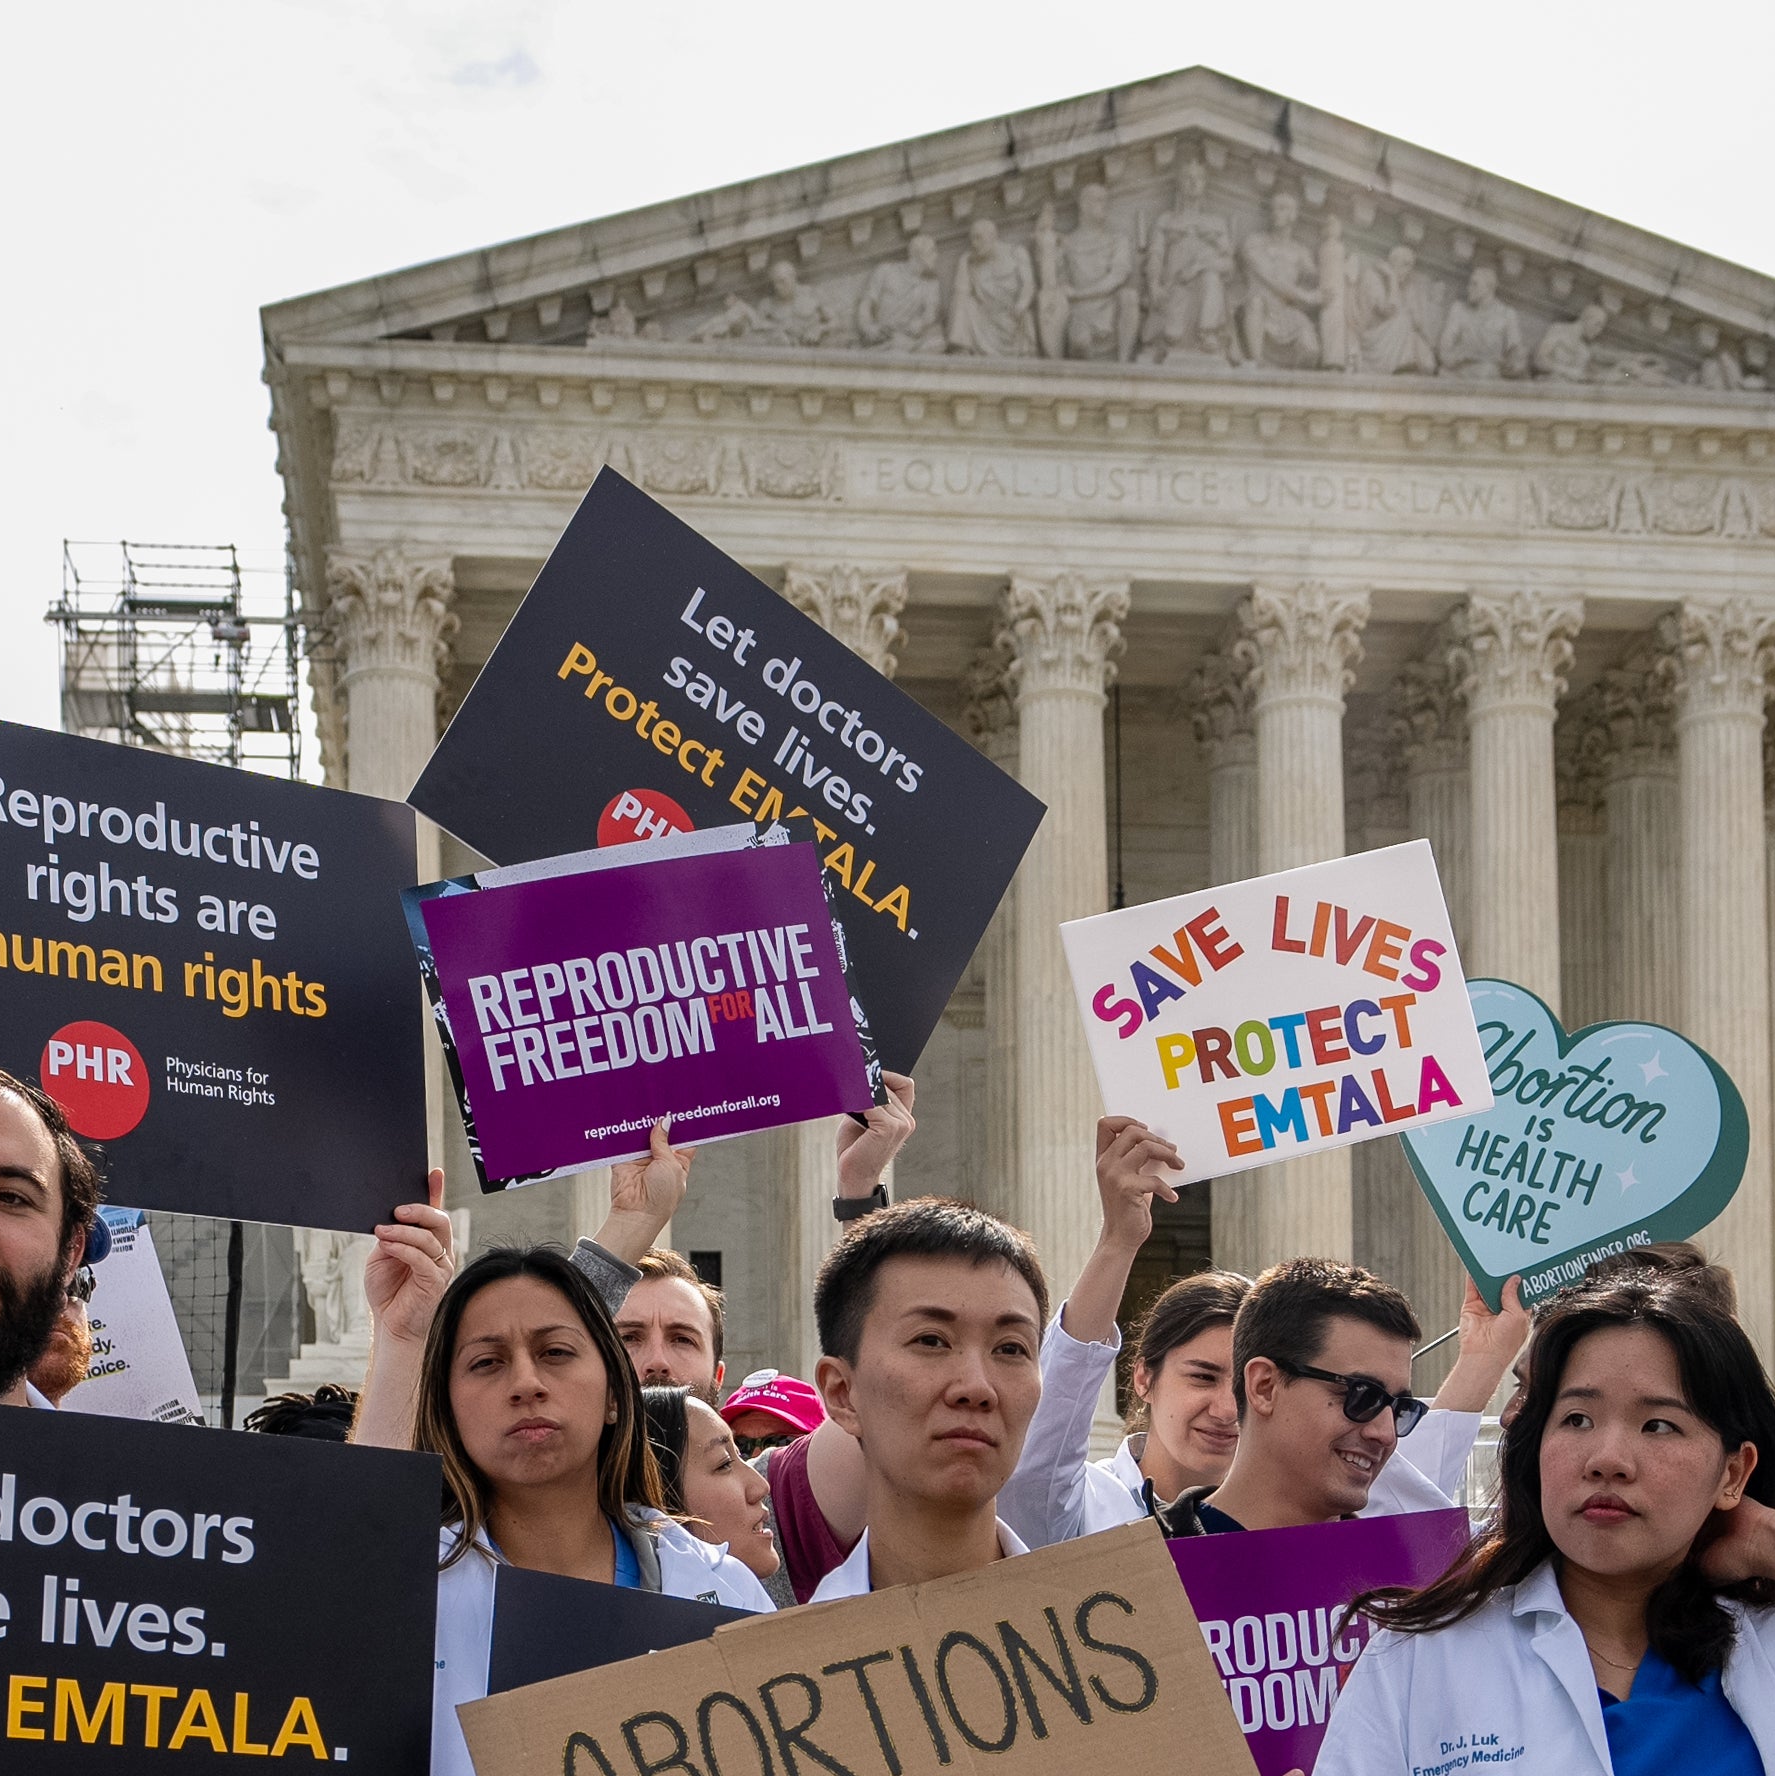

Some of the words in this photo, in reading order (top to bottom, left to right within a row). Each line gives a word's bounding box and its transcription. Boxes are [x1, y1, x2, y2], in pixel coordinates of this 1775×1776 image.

[876, 457, 1030, 500] EQUAL
[1034, 463, 1219, 506] JUSTICE
[1244, 472, 1394, 513] UNDER
[1413, 482, 1494, 517] LAW
[557, 641, 724, 789] Protect
[680, 588, 757, 667] Let
[762, 658, 924, 794] doctors
[662, 655, 767, 747] save
[775, 727, 876, 836] lives.
[25, 858, 179, 926] rights
[197, 895, 277, 942] are
[183, 950, 328, 1019] rights
[468, 923, 819, 1033] REPRODUCTIVE
[1091, 906, 1244, 1039] SAVE
[1271, 895, 1448, 993] LIVES
[48, 1038, 135, 1089] PHR
[165, 1055, 238, 1087] Physicians
[244, 1066, 270, 1086] for
[483, 999, 716, 1091] FREEDOM
[707, 988, 754, 1024] FOR
[756, 981, 832, 1043] ALL
[1156, 993, 1417, 1090] PROTECT
[166, 1076, 225, 1102] Human
[229, 1083, 276, 1107] Rights
[1216, 1054, 1463, 1159] EMTALA
[1455, 1125, 1603, 1206] HEALTH
[1463, 1181, 1560, 1245] CARE
[42, 1575, 226, 1657] lives.
[6, 1675, 349, 1762] EMTALA.
[1440, 1741, 1455, 1755] Dr.
[1456, 1736, 1467, 1749] J.
[1472, 1734, 1499, 1746] Luk
[1472, 1746, 1524, 1764] Medicine
